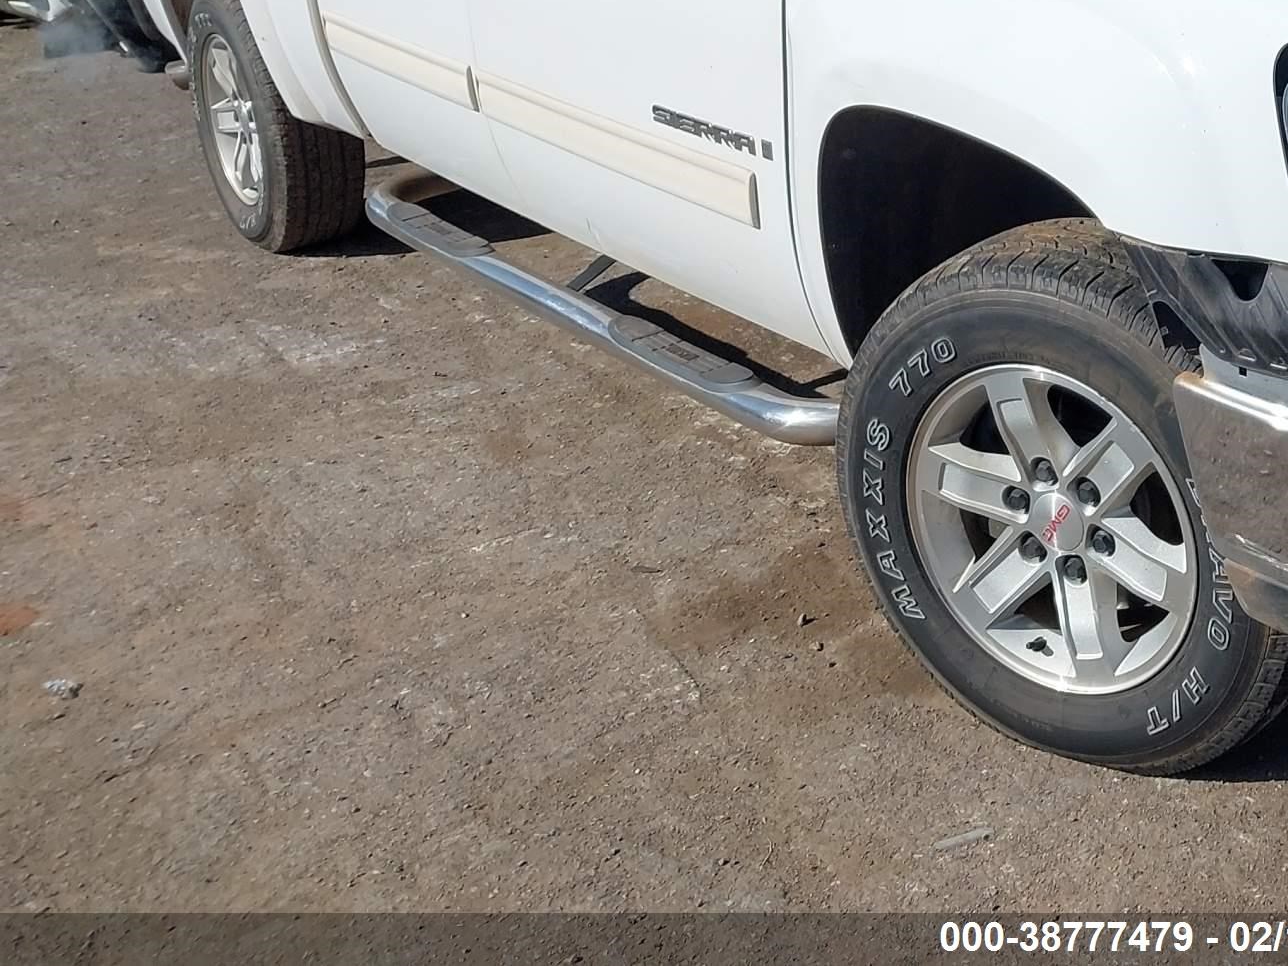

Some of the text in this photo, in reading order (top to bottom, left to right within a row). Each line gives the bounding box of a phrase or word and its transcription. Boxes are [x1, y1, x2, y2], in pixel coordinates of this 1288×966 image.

[651, 103, 757, 157] SIERRA
[889, 337, 957, 397] 770
[863, 419, 926, 621] MAXXIS
[1042, 504, 1071, 542] GMC
[1146, 665, 1210, 735] H/T
